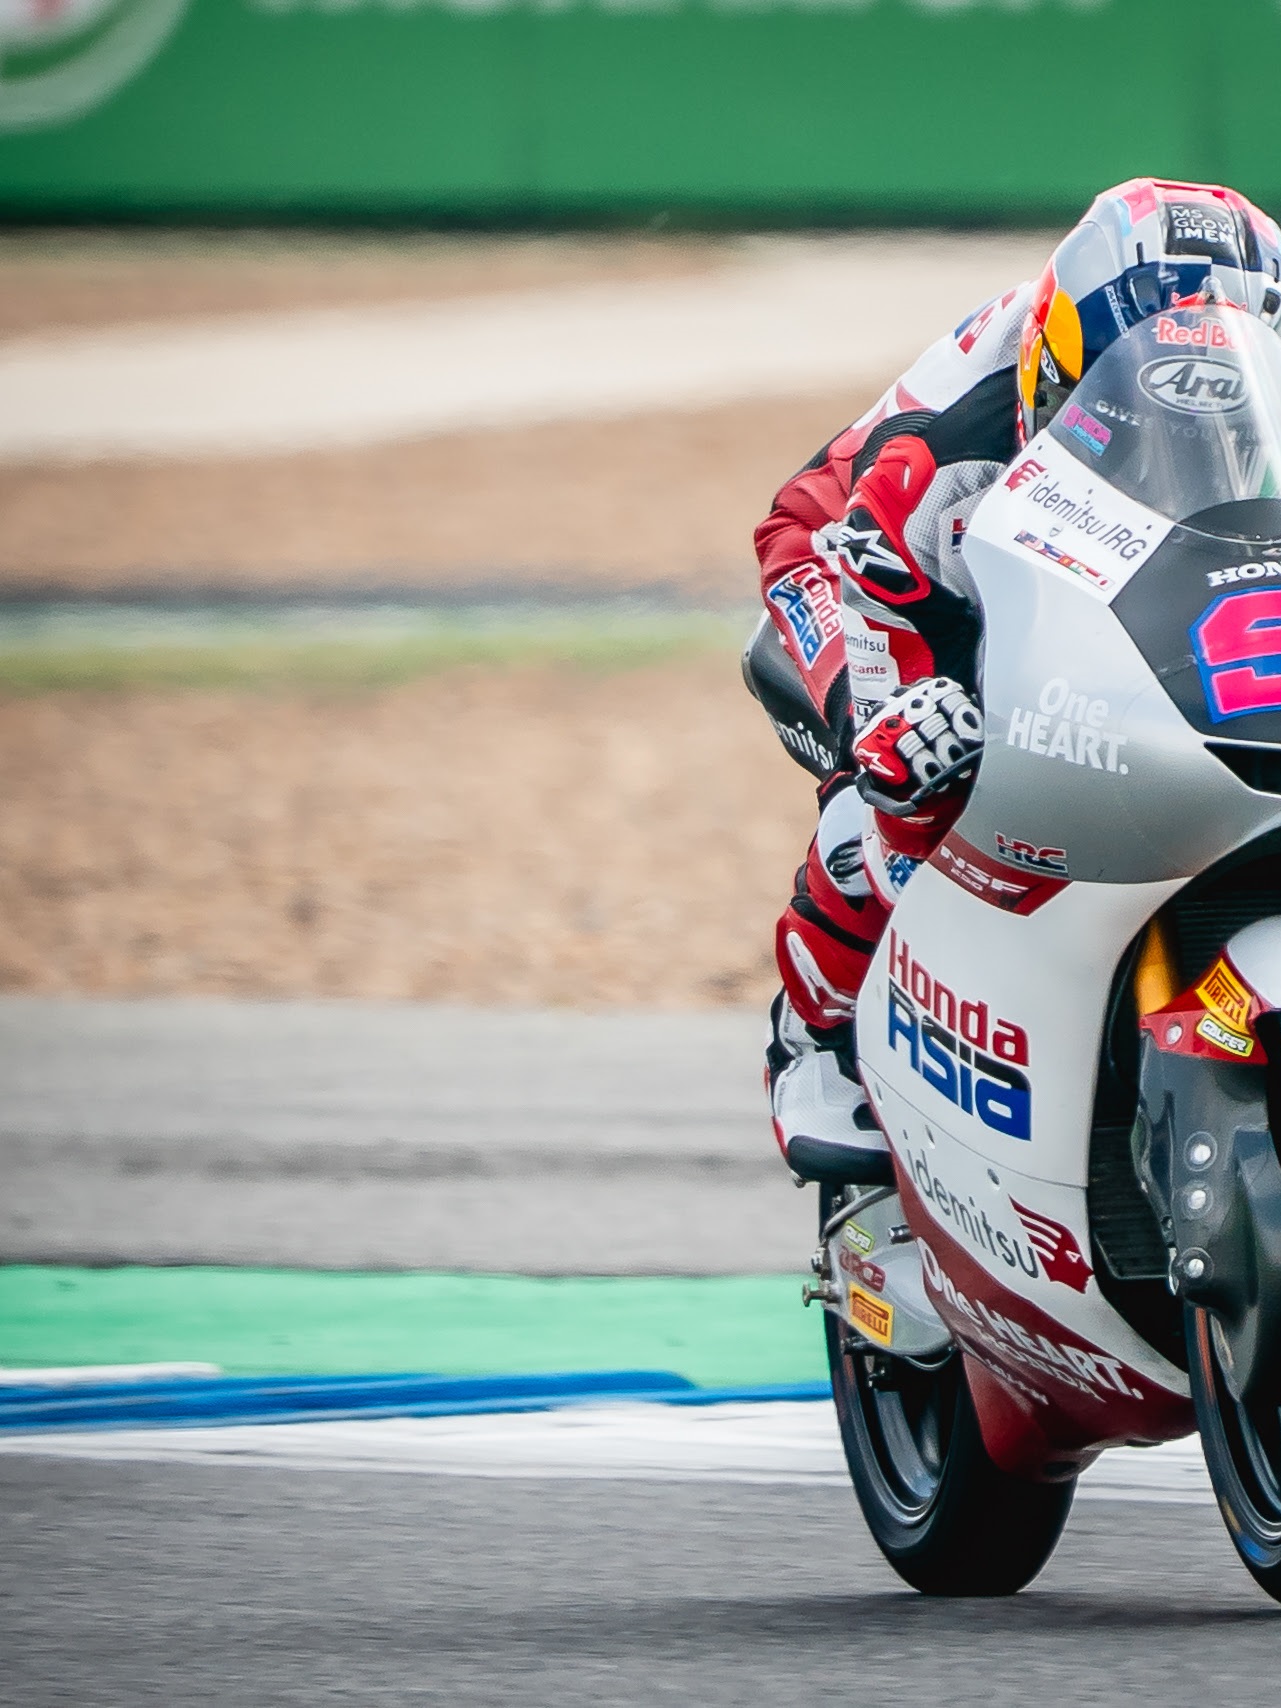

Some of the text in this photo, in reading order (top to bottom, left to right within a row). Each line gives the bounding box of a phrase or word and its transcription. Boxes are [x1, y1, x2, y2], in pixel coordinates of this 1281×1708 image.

[1170, 207, 1203, 219] MS
[1174, 218, 1236, 234] GLOW
[1156, 317, 1208, 347] Red
[1027, 474, 1148, 561] idemitsu IRG
[849, 664, 888, 675] cants
[1038, 677, 1109, 728] One
[1006, 706, 1130, 776] HEART.
[940, 844, 1029, 893] NSF
[888, 926, 1030, 1067] Honda
[1203, 966, 1246, 1025] PIRELLI
[903, 1129, 1040, 1279] idemitsu
[915, 1236, 985, 1327] One
